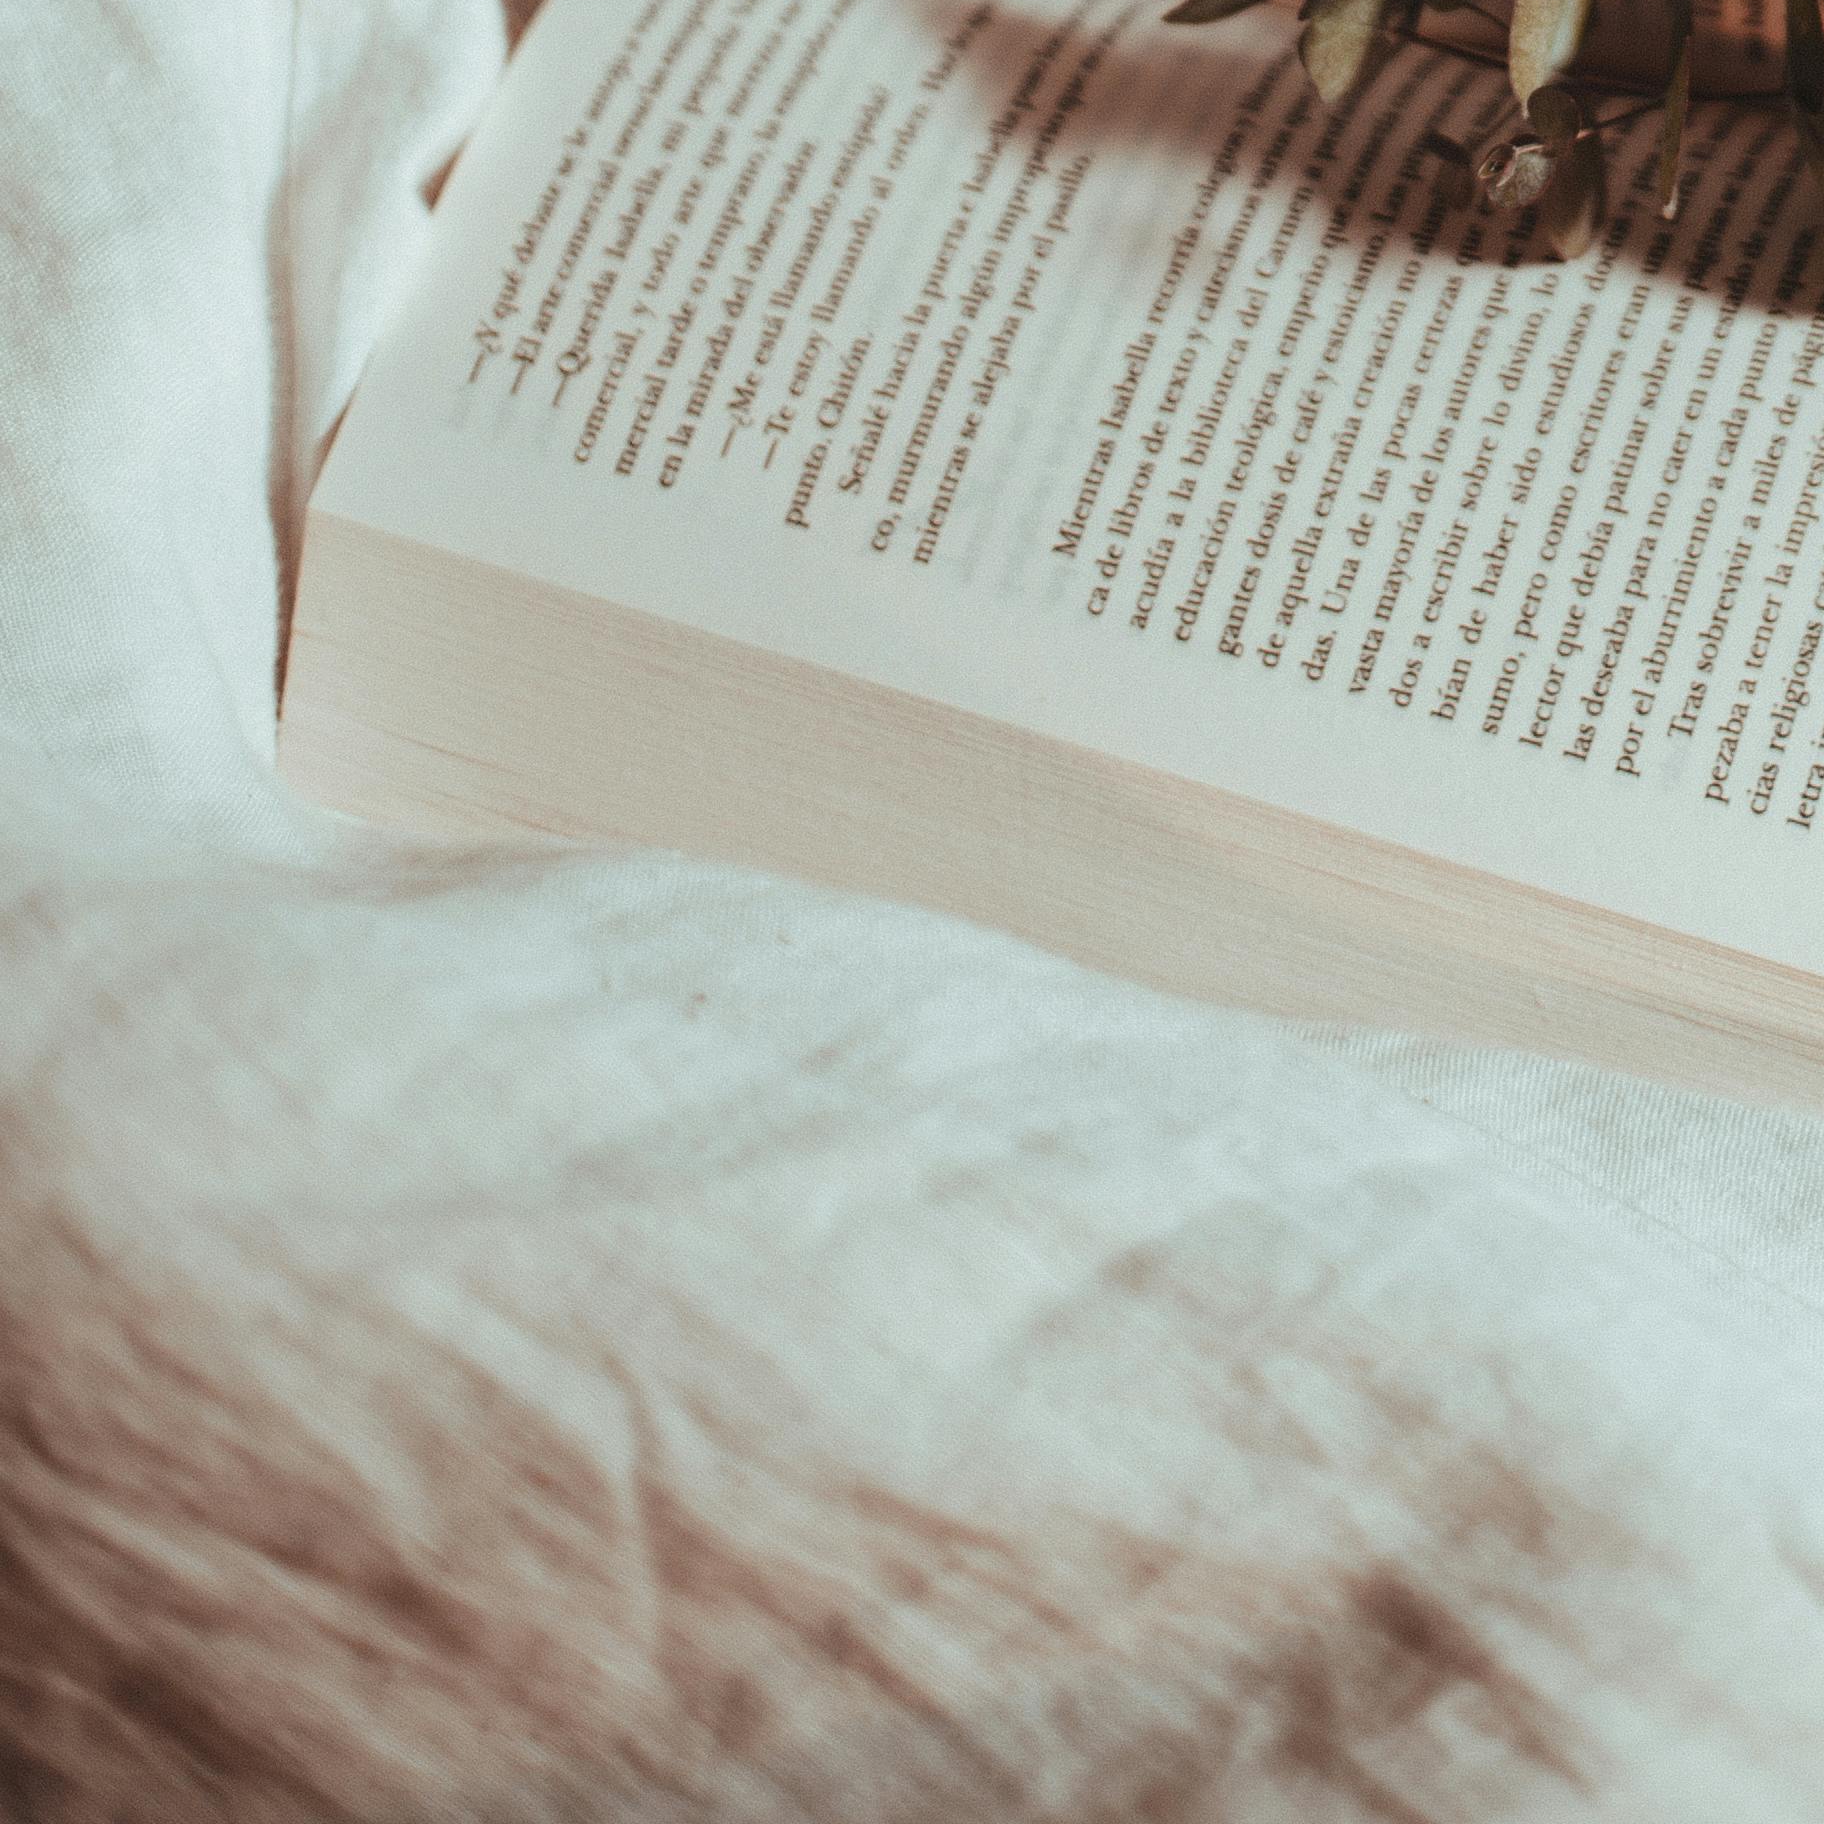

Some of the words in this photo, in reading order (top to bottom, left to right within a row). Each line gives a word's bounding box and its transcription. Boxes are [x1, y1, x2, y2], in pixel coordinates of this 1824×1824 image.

[490, 267, 525, 323] qué
[506, 180, 565, 266] debate
[530, 283, 566, 335] arte
[553, 158, 621, 282] comercial
[569, 328, 646, 465] comercial,
[637, 231, 681, 294] todo
[671, 177, 706, 226] arte
[697, 127, 731, 172] que
[612, 371, 668, 477] mercial
[651, 300, 699, 371] tarde
[693, 149, 773, 272] temprano,
[767, 191, 840, 311] llamando
[808, 204, 880, 326] llamando
[1665, 292, 1696, 334] sus
[1710, 260, 1757, 342] estado
[684, 322, 736, 417] mirada
[717, 273, 755, 319] del
[750, 310, 786, 366] está
[785, 328, 833, 398] estoy
[834, 400, 892, 495] Señalé
[872, 329, 922, 401] hacia
[920, 216, 970, 302] puerta
[887, 323, 971, 504] murmurando
[958, 247, 1004, 320] algún
[911, 443, 971, 565] mientras
[970, 313, 1023, 406] alejaba
[1010, 261, 1044, 313] por
[1044, 153, 1094, 233] pasillo.
[1049, 435, 1117, 557] Mientras
[1097, 330, 1157, 433] Isabella
[1145, 224, 1201, 326] recorría
[1105, 458, 1155, 540] libros
[1153, 344, 1199, 416] texto
[1193, 191, 1264, 324] catecismos
[1128, 535, 1176, 630] acudía
[1179, 336, 1249, 469] biblioteca
[1231, 283, 1270, 329] del
[1251, 179, 1318, 282] Carmen
[1170, 498, 1238, 643] educación
[1220, 365, 1292, 495] teológica,
[1275, 252, 1332, 358] empeño
[1319, 204, 1354, 255] que
[1637, 336, 1679, 411] sobre
[783, 440, 832, 531] punto.
[812, 333, 876, 432] Chitón.
[1215, 564, 1263, 659] gantes
[1242, 489, 1289, 560] dosis
[1289, 385, 1325, 446] café
[1319, 230, 1391, 365] estoicismo.
[1274, 522, 1325, 628] aquella
[1311, 413, 1364, 520] extraña
[1350, 296, 1408, 411] creación
[1297, 628, 1339, 683] das.
[1319, 553, 1362, 618] Una
[1357, 465, 1393, 505] las
[1380, 379, 1424, 462] pocas
[1411, 271, 1466, 376] certezas
[1452, 222, 1486, 272] que
[1347, 624, 1387, 696] vasta
[1373, 506, 1427, 622] mayoría
[1419, 424, 1456, 465] los
[1442, 323, 1493, 422] autores
[1479, 270, 1514, 324] que
[1385, 655, 1424, 710] dos
[1419, 517, 1470, 624] escribir
[1457, 434, 1500, 512] sobre
[1493, 307, 1551, 394] divino,
[1428, 655, 1472, 723] bían
[1469, 513, 1520, 600] haber
[1507, 444, 1544, 505] sido
[1532, 298, 1598, 437] estudiosos
[1479, 652, 1529, 736] sumo,
[1512, 571, 1550, 643] pero
[1537, 482, 1579, 563] como
[1566, 345, 1628, 476] escritores
[1614, 282, 1653, 342] eran
[1602, 414, 1651, 516] patinar
[1660, 424, 1695, 486] caer
[1554, 602, 1588, 662] que
[1567, 517, 1616, 599] debía
[1612, 721, 1646, 778] por
[1641, 494, 1720, 685] aburrimiento
[1713, 404, 1751, 470] cada
[1737, 319, 1782, 404] punto
[1623, 532, 1660, 602] para
[1664, 677, 1708, 745] Tras
[1694, 536, 1754, 675] sobrevivir
[1749, 432, 1789, 507] miles
[1515, 663, 1567, 750] lector
[1559, 719, 1597, 763] las
[1576, 602, 1637, 718] deseaba
[1703, 699, 1750, 807] pezaba
[1739, 592, 1785, 672] tener
[1746, 758, 1781, 817] cias
